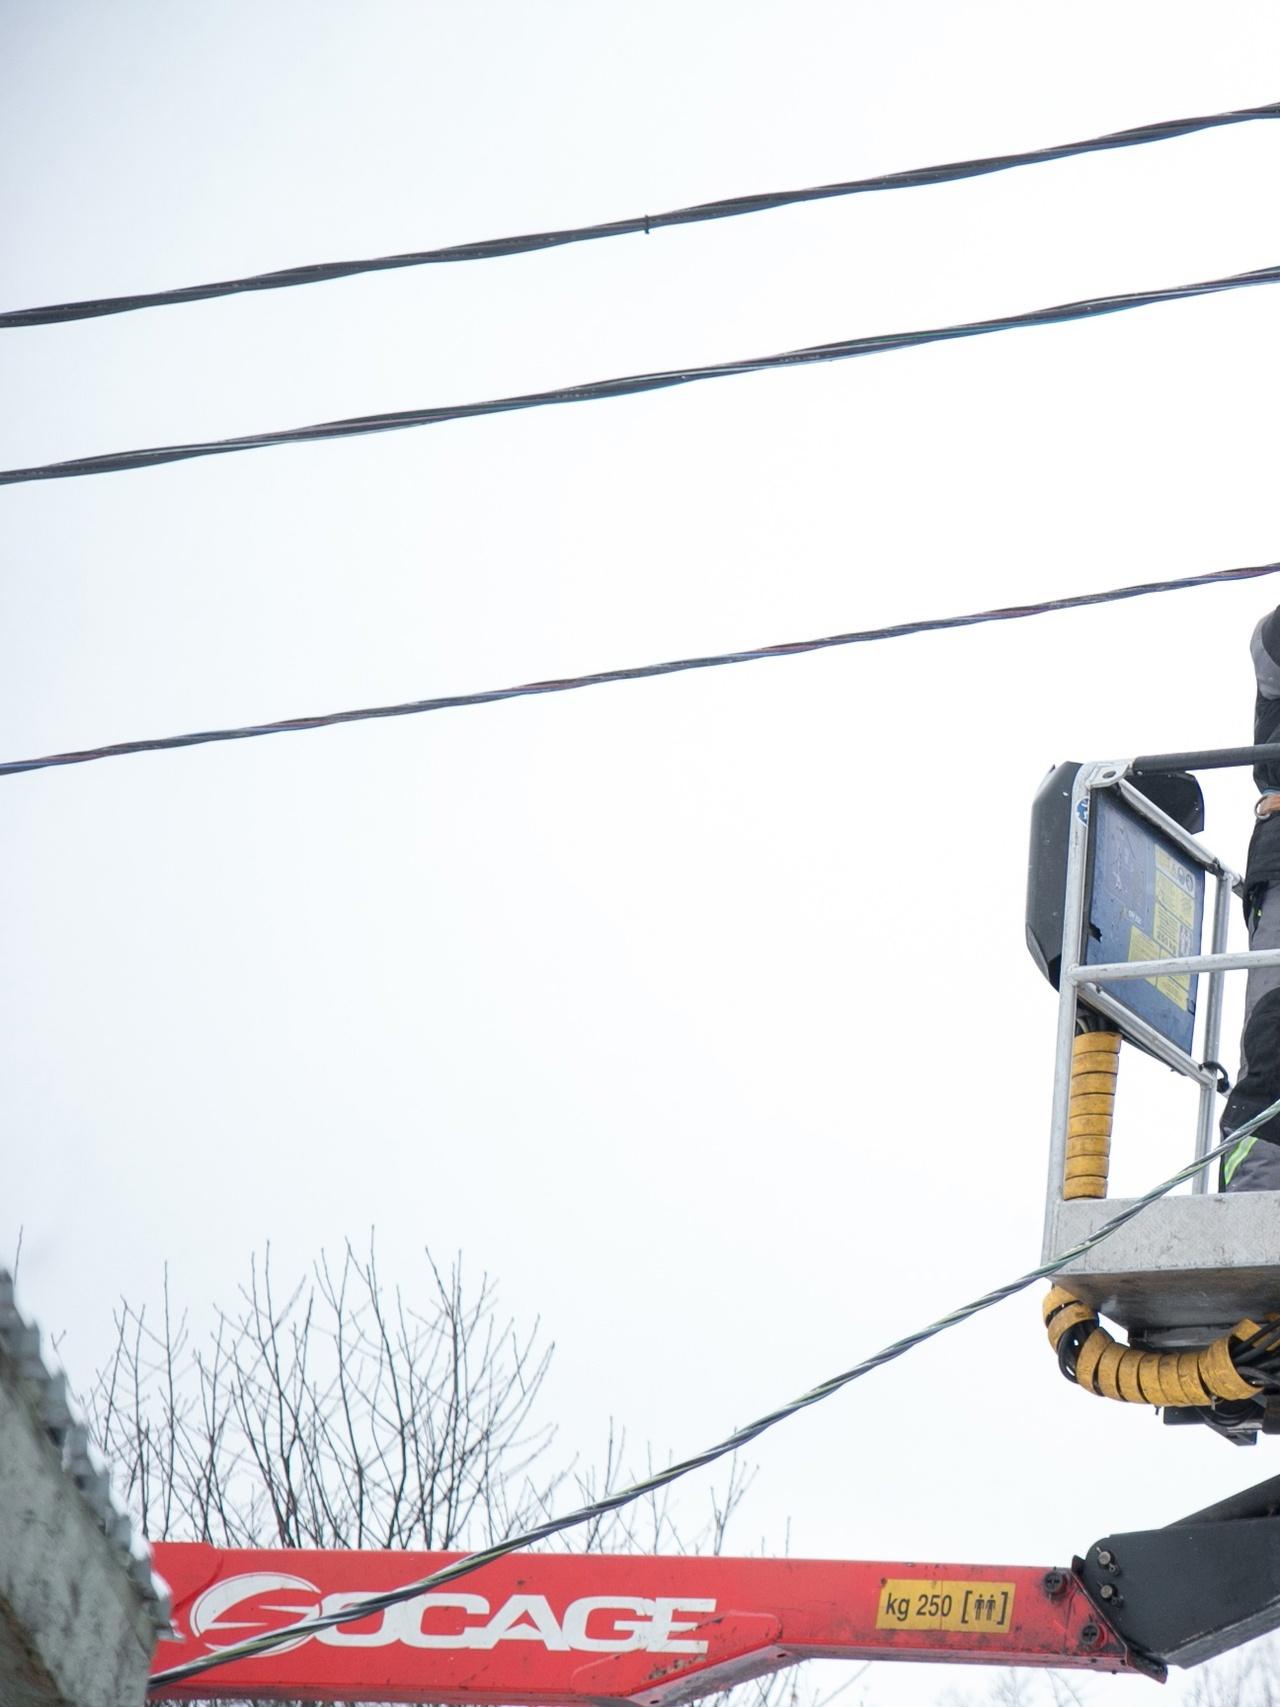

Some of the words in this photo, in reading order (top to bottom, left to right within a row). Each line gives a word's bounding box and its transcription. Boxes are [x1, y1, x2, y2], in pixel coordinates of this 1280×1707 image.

[189, 1572, 717, 1658] SOCAGE
[886, 1593, 911, 1621] kg
[916, 1594, 952, 1616] 250
